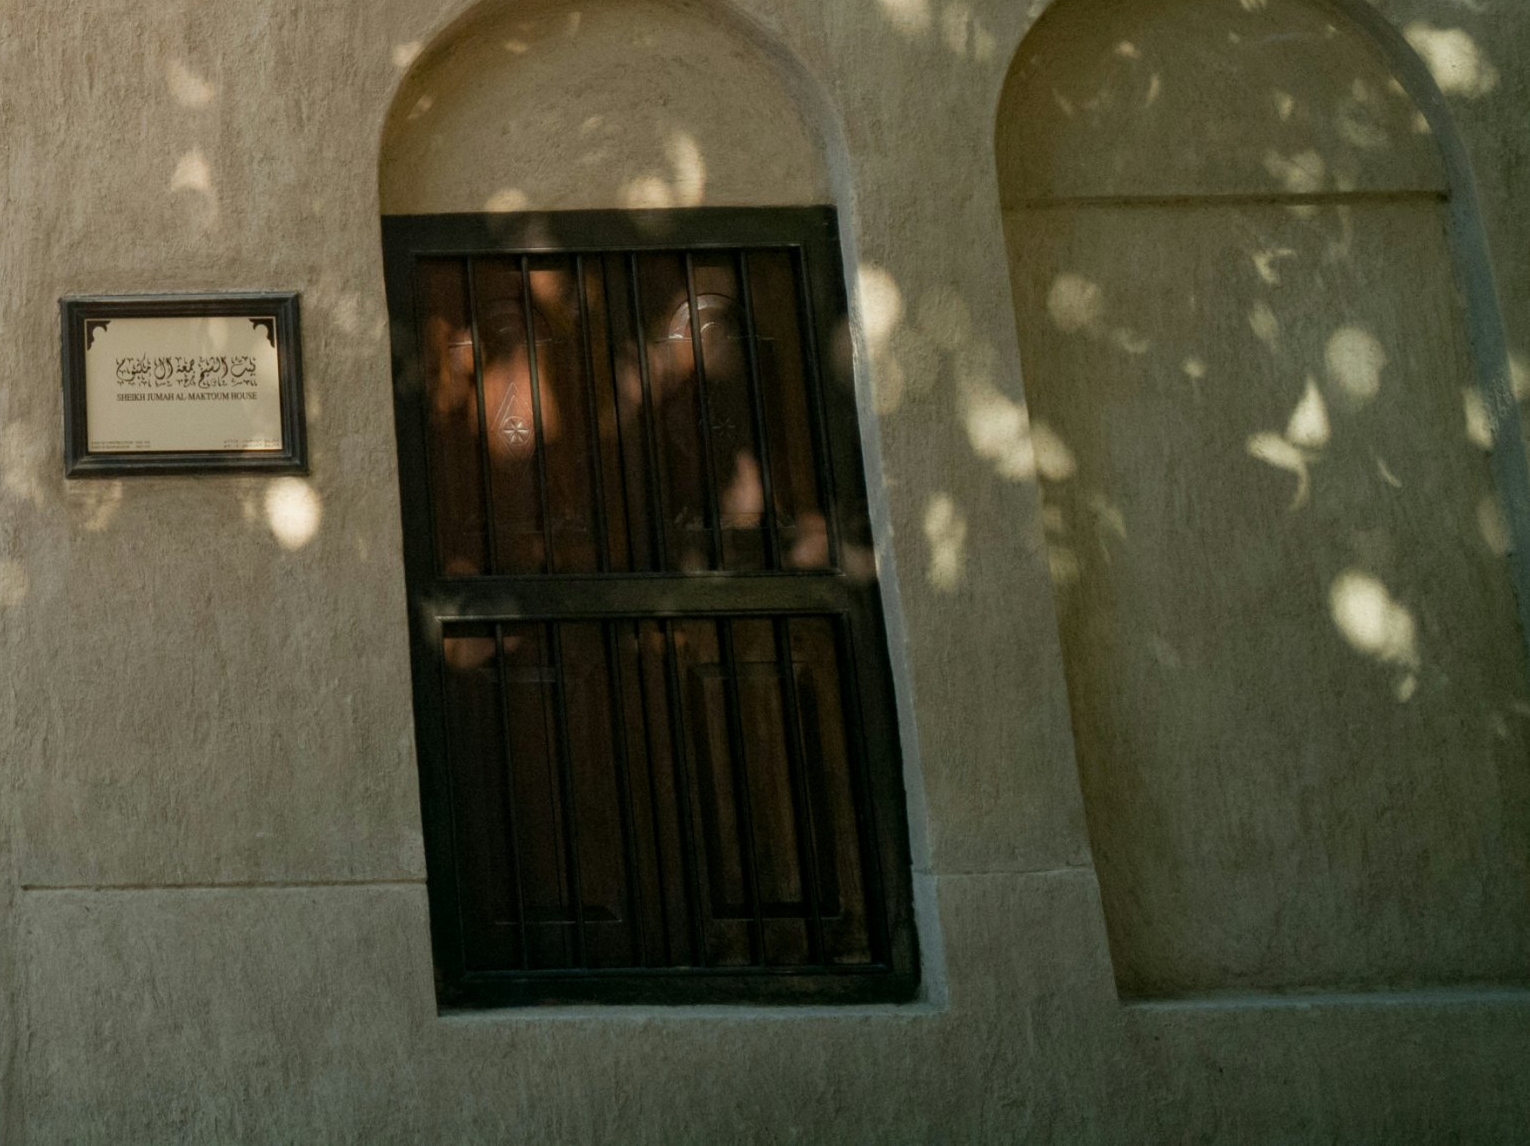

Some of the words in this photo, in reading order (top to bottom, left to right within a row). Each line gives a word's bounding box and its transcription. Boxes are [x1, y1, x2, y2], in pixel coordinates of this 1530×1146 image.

[116, 393, 146, 402] SHEIKH
[147, 393, 174, 402] JUMAH
[175, 392, 229, 401] AL-MAKTOUM
[231, 392, 258, 400] HOUSE
